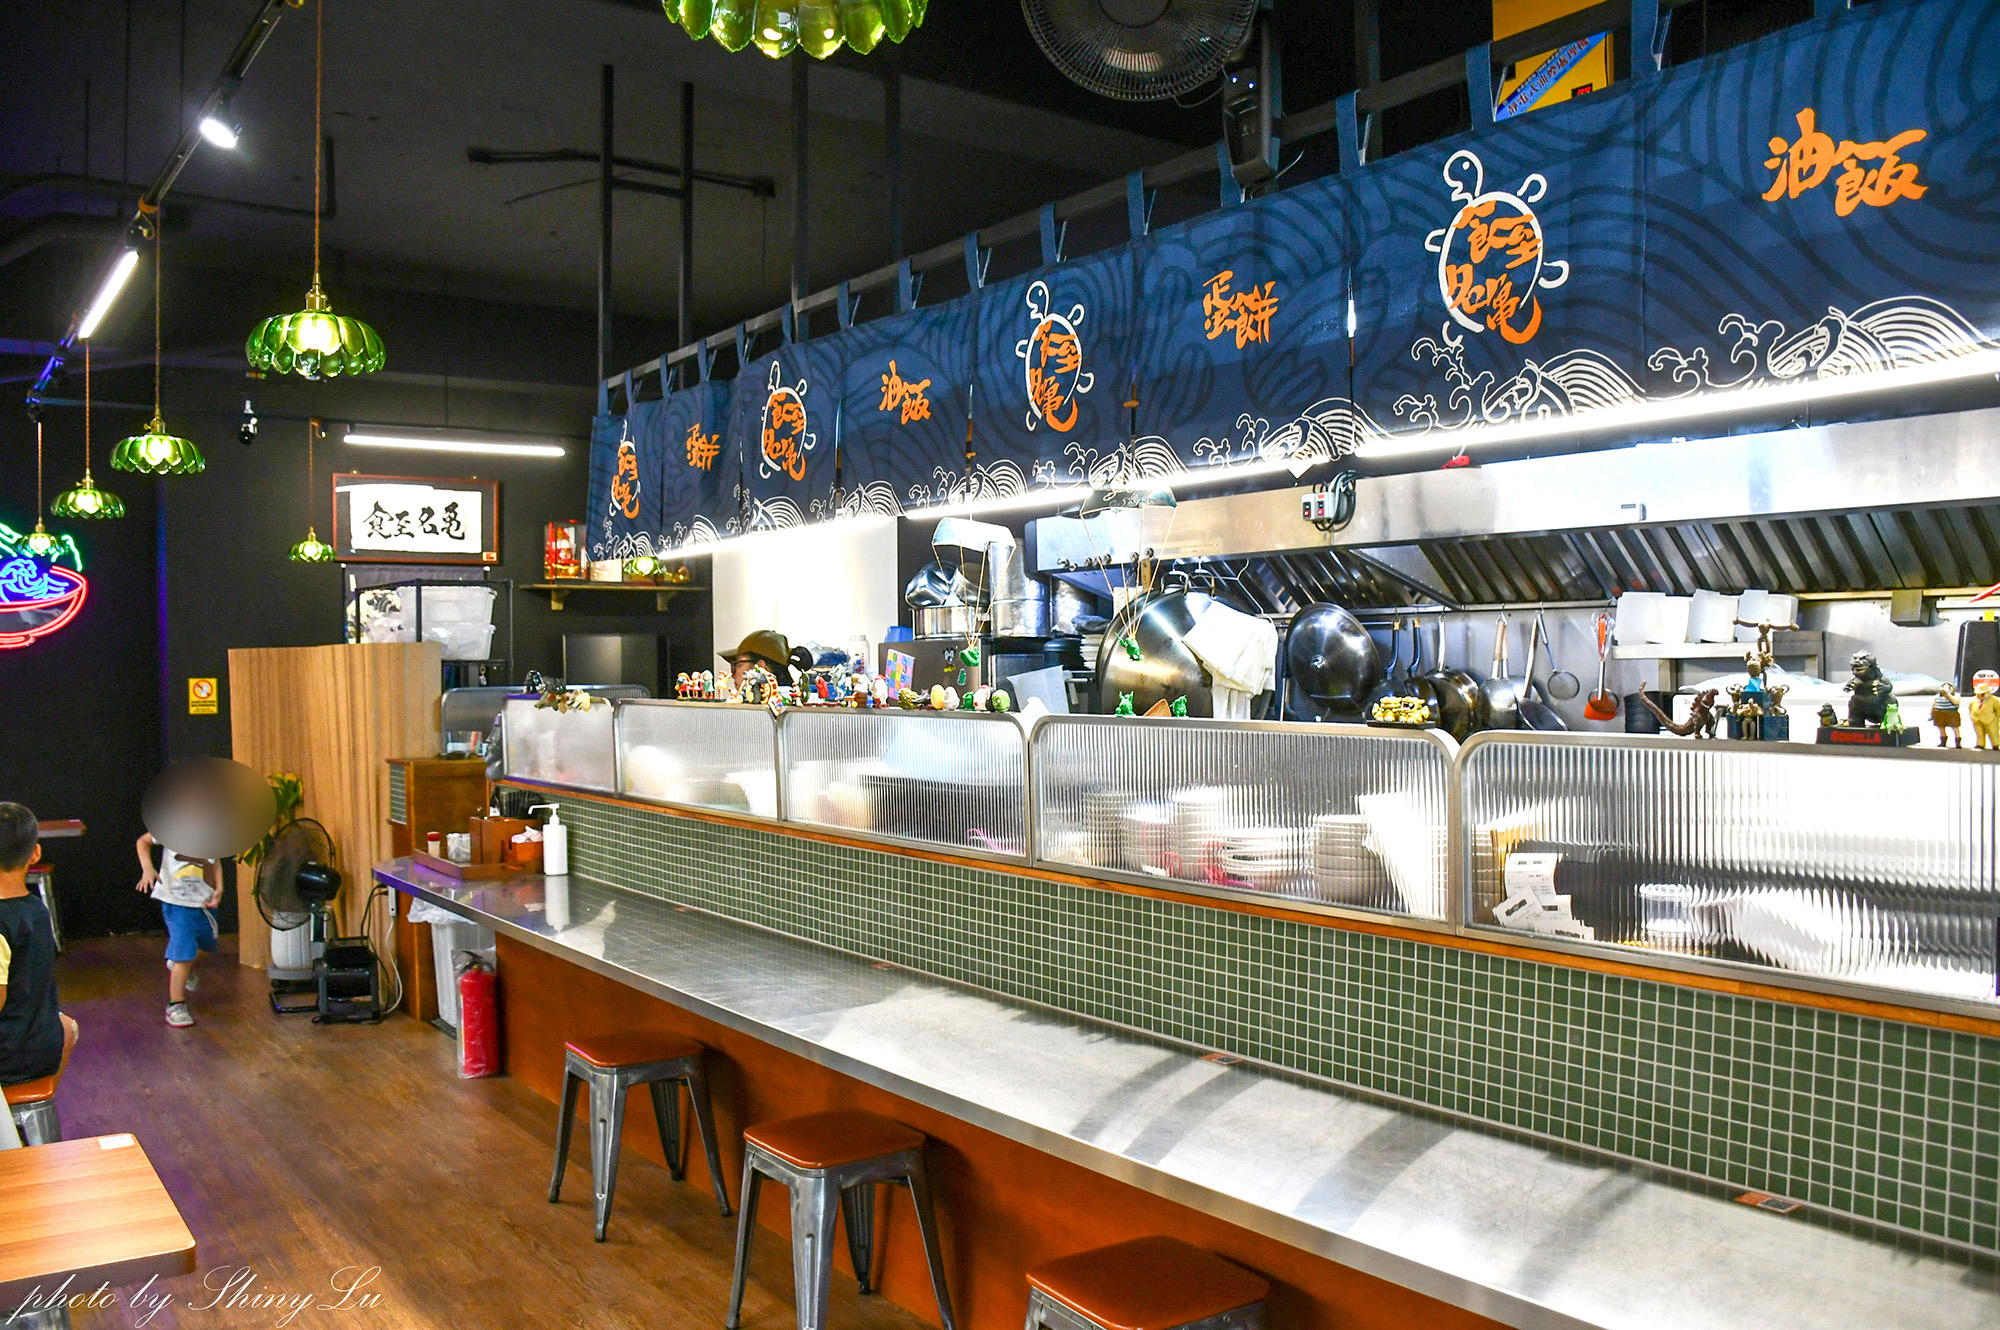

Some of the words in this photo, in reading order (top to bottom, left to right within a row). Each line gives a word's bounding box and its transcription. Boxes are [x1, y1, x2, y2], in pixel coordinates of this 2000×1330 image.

[1762, 107, 1928, 217] 油飯
[1202, 269, 1279, 349] 蛋餅
[879, 359, 931, 425] 油飯
[686, 423, 721, 471] 蛋餅
[1830, 730, 1882, 745] GODZILLA
